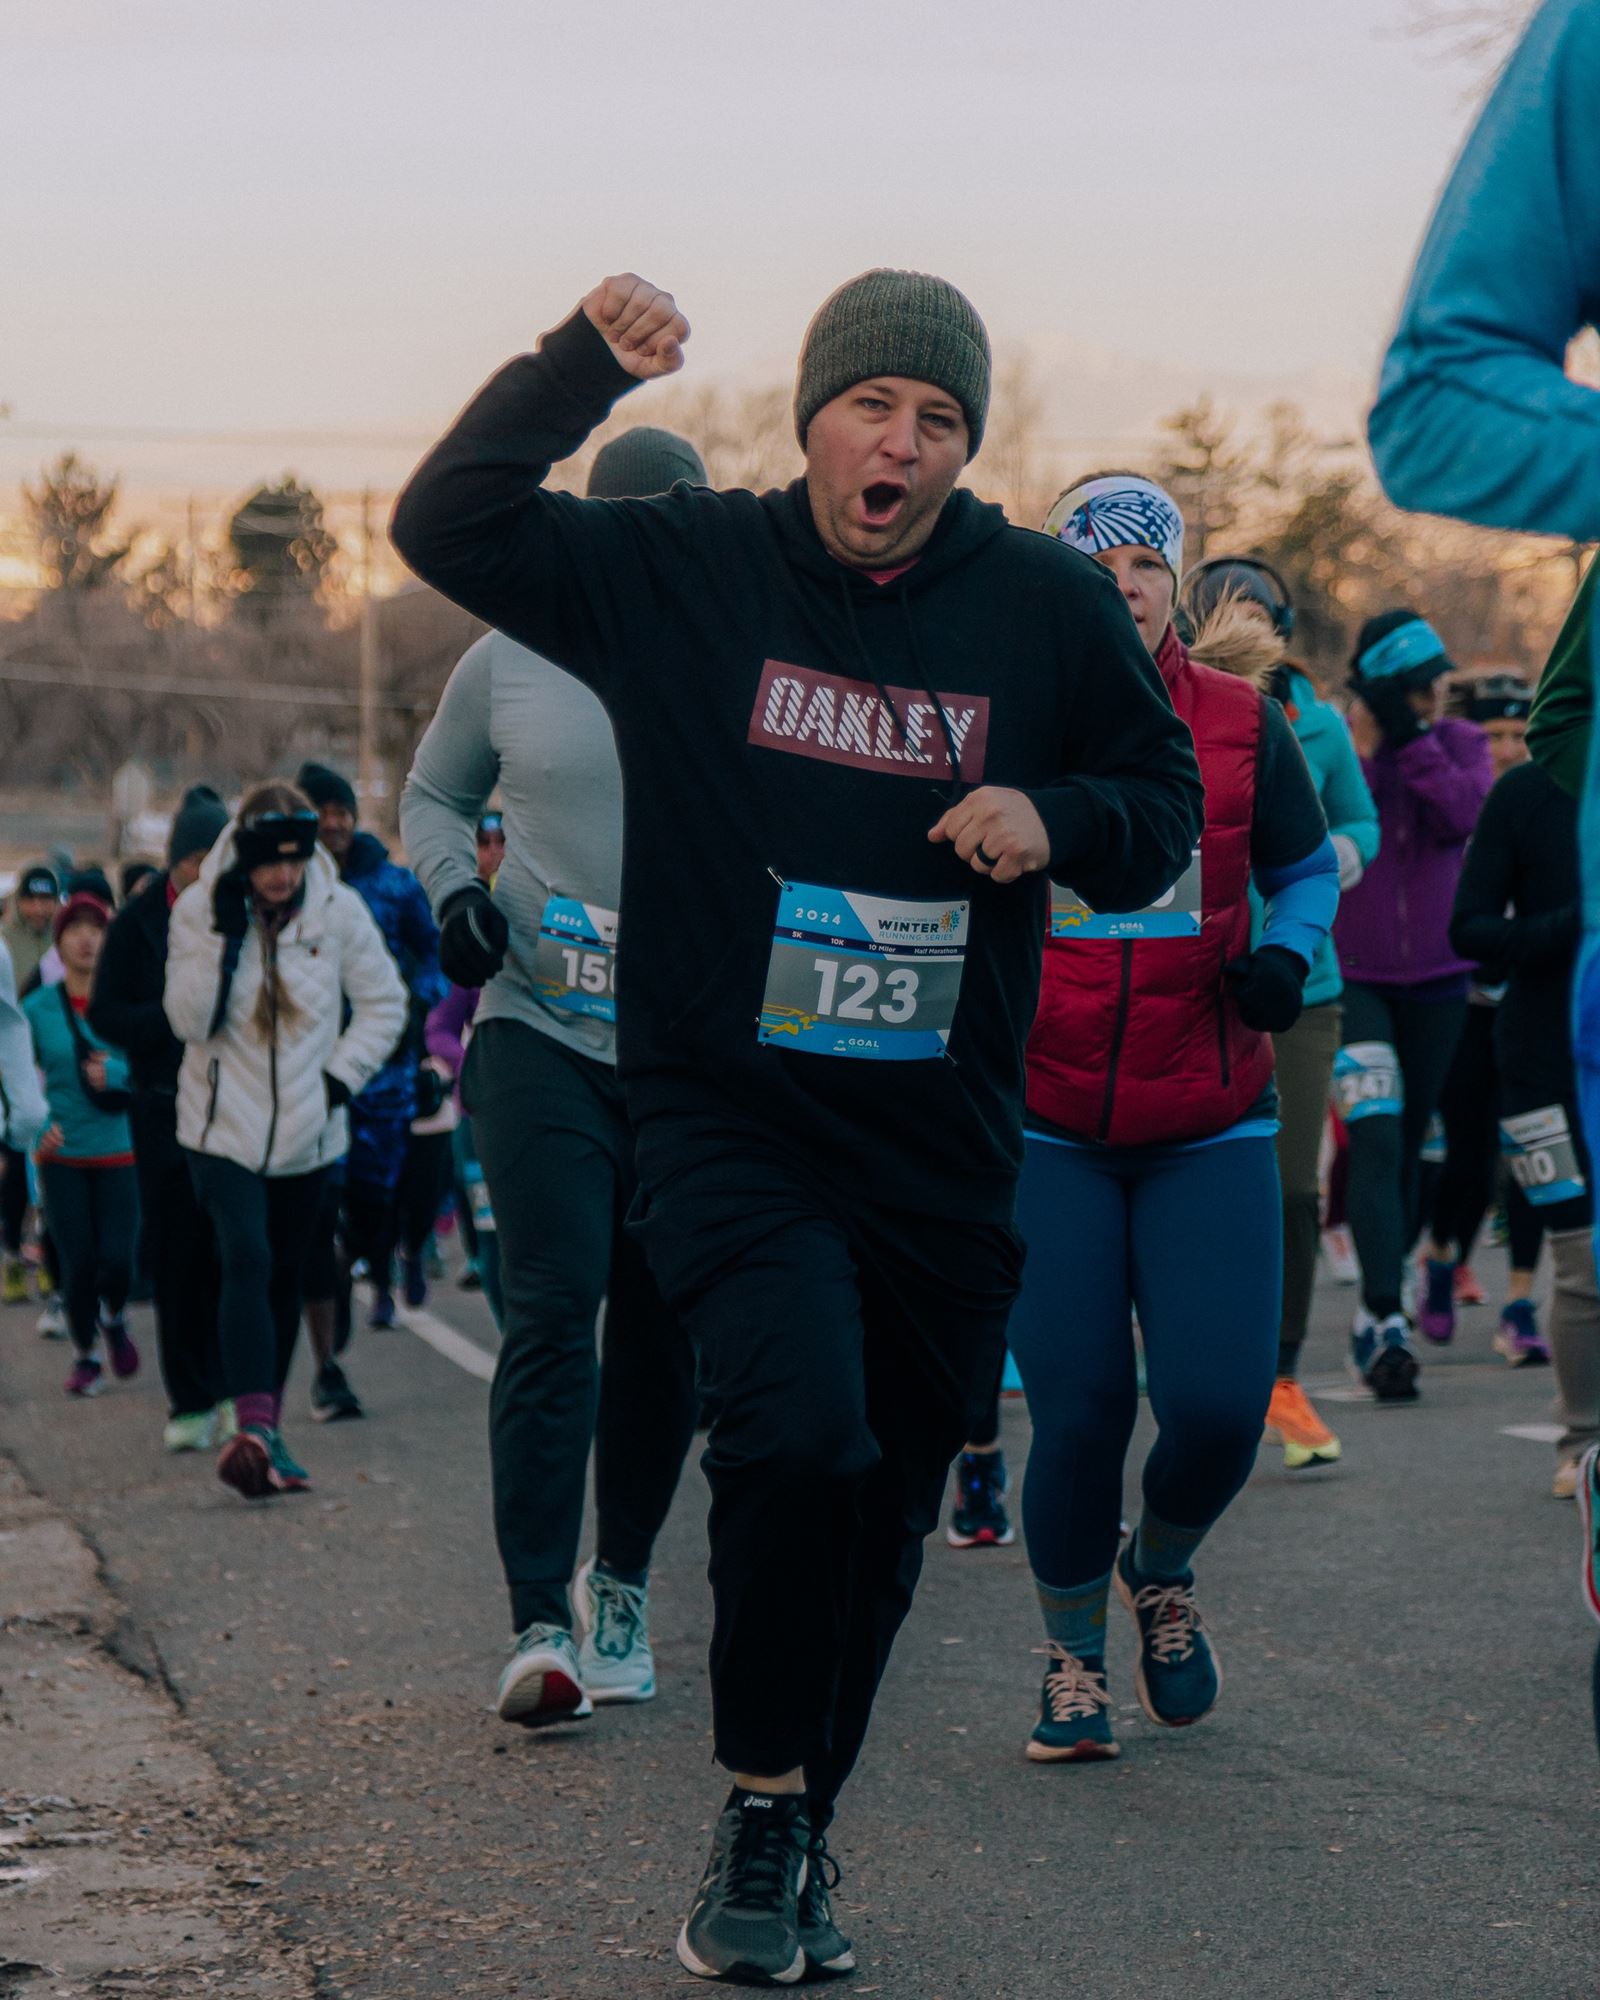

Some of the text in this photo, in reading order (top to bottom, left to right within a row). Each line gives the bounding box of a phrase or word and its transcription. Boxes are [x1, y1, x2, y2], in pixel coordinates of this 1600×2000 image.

[763, 677, 976, 766] OAKLEY
[795, 907, 841, 926] 2024
[878, 919, 939, 934] WINTER
[792, 931, 802, 939] 5K
[831, 938, 844, 946] 10K
[878, 944, 897, 954] Miler
[914, 947, 928, 955] Half
[928, 947, 958, 955] Marathon
[879, 930, 954, 942] RUNNING SERIES
[561, 948, 616, 994] 15
[814, 958, 919, 1024] 123
[848, 1038, 880, 1048] GOAL
